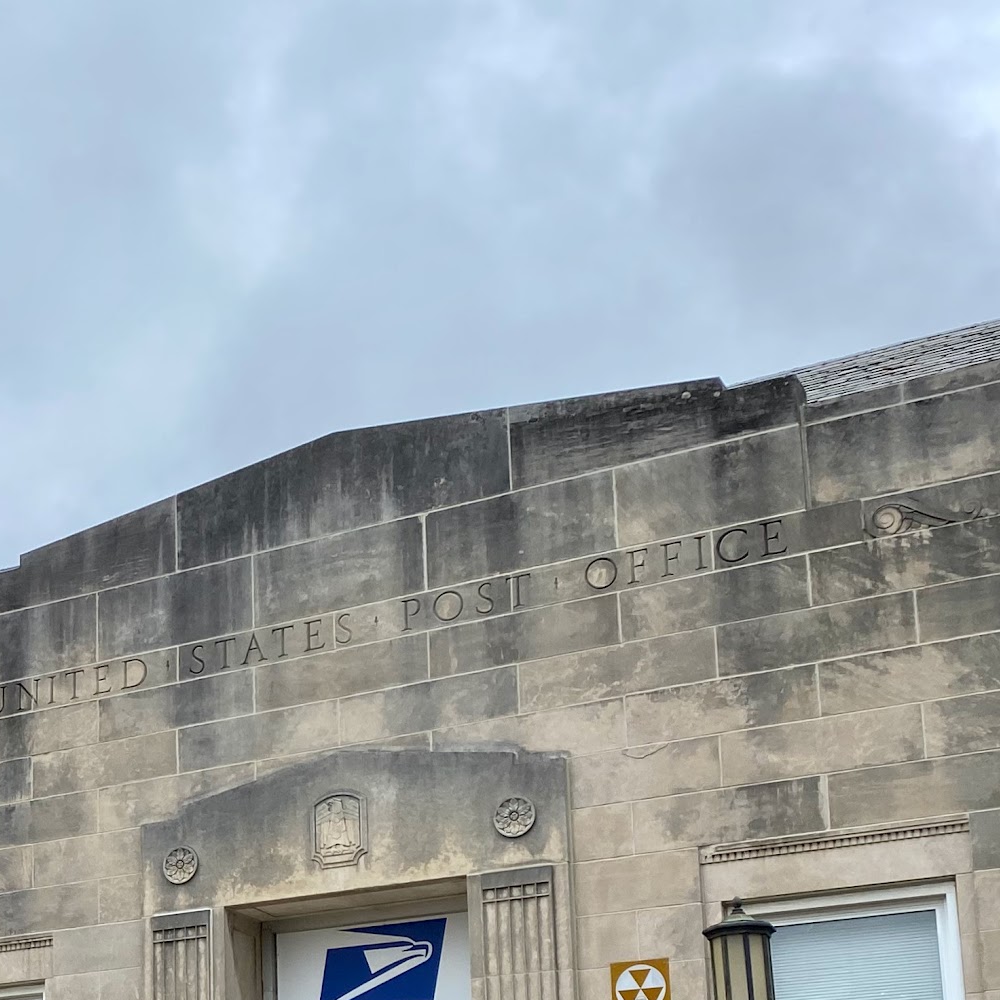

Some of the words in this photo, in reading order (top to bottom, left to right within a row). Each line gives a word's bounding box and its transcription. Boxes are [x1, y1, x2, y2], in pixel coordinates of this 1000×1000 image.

[189, 613, 353, 675] STATES
[401, 573, 531, 632] POST
[585, 519, 788, 589] OFFICE
